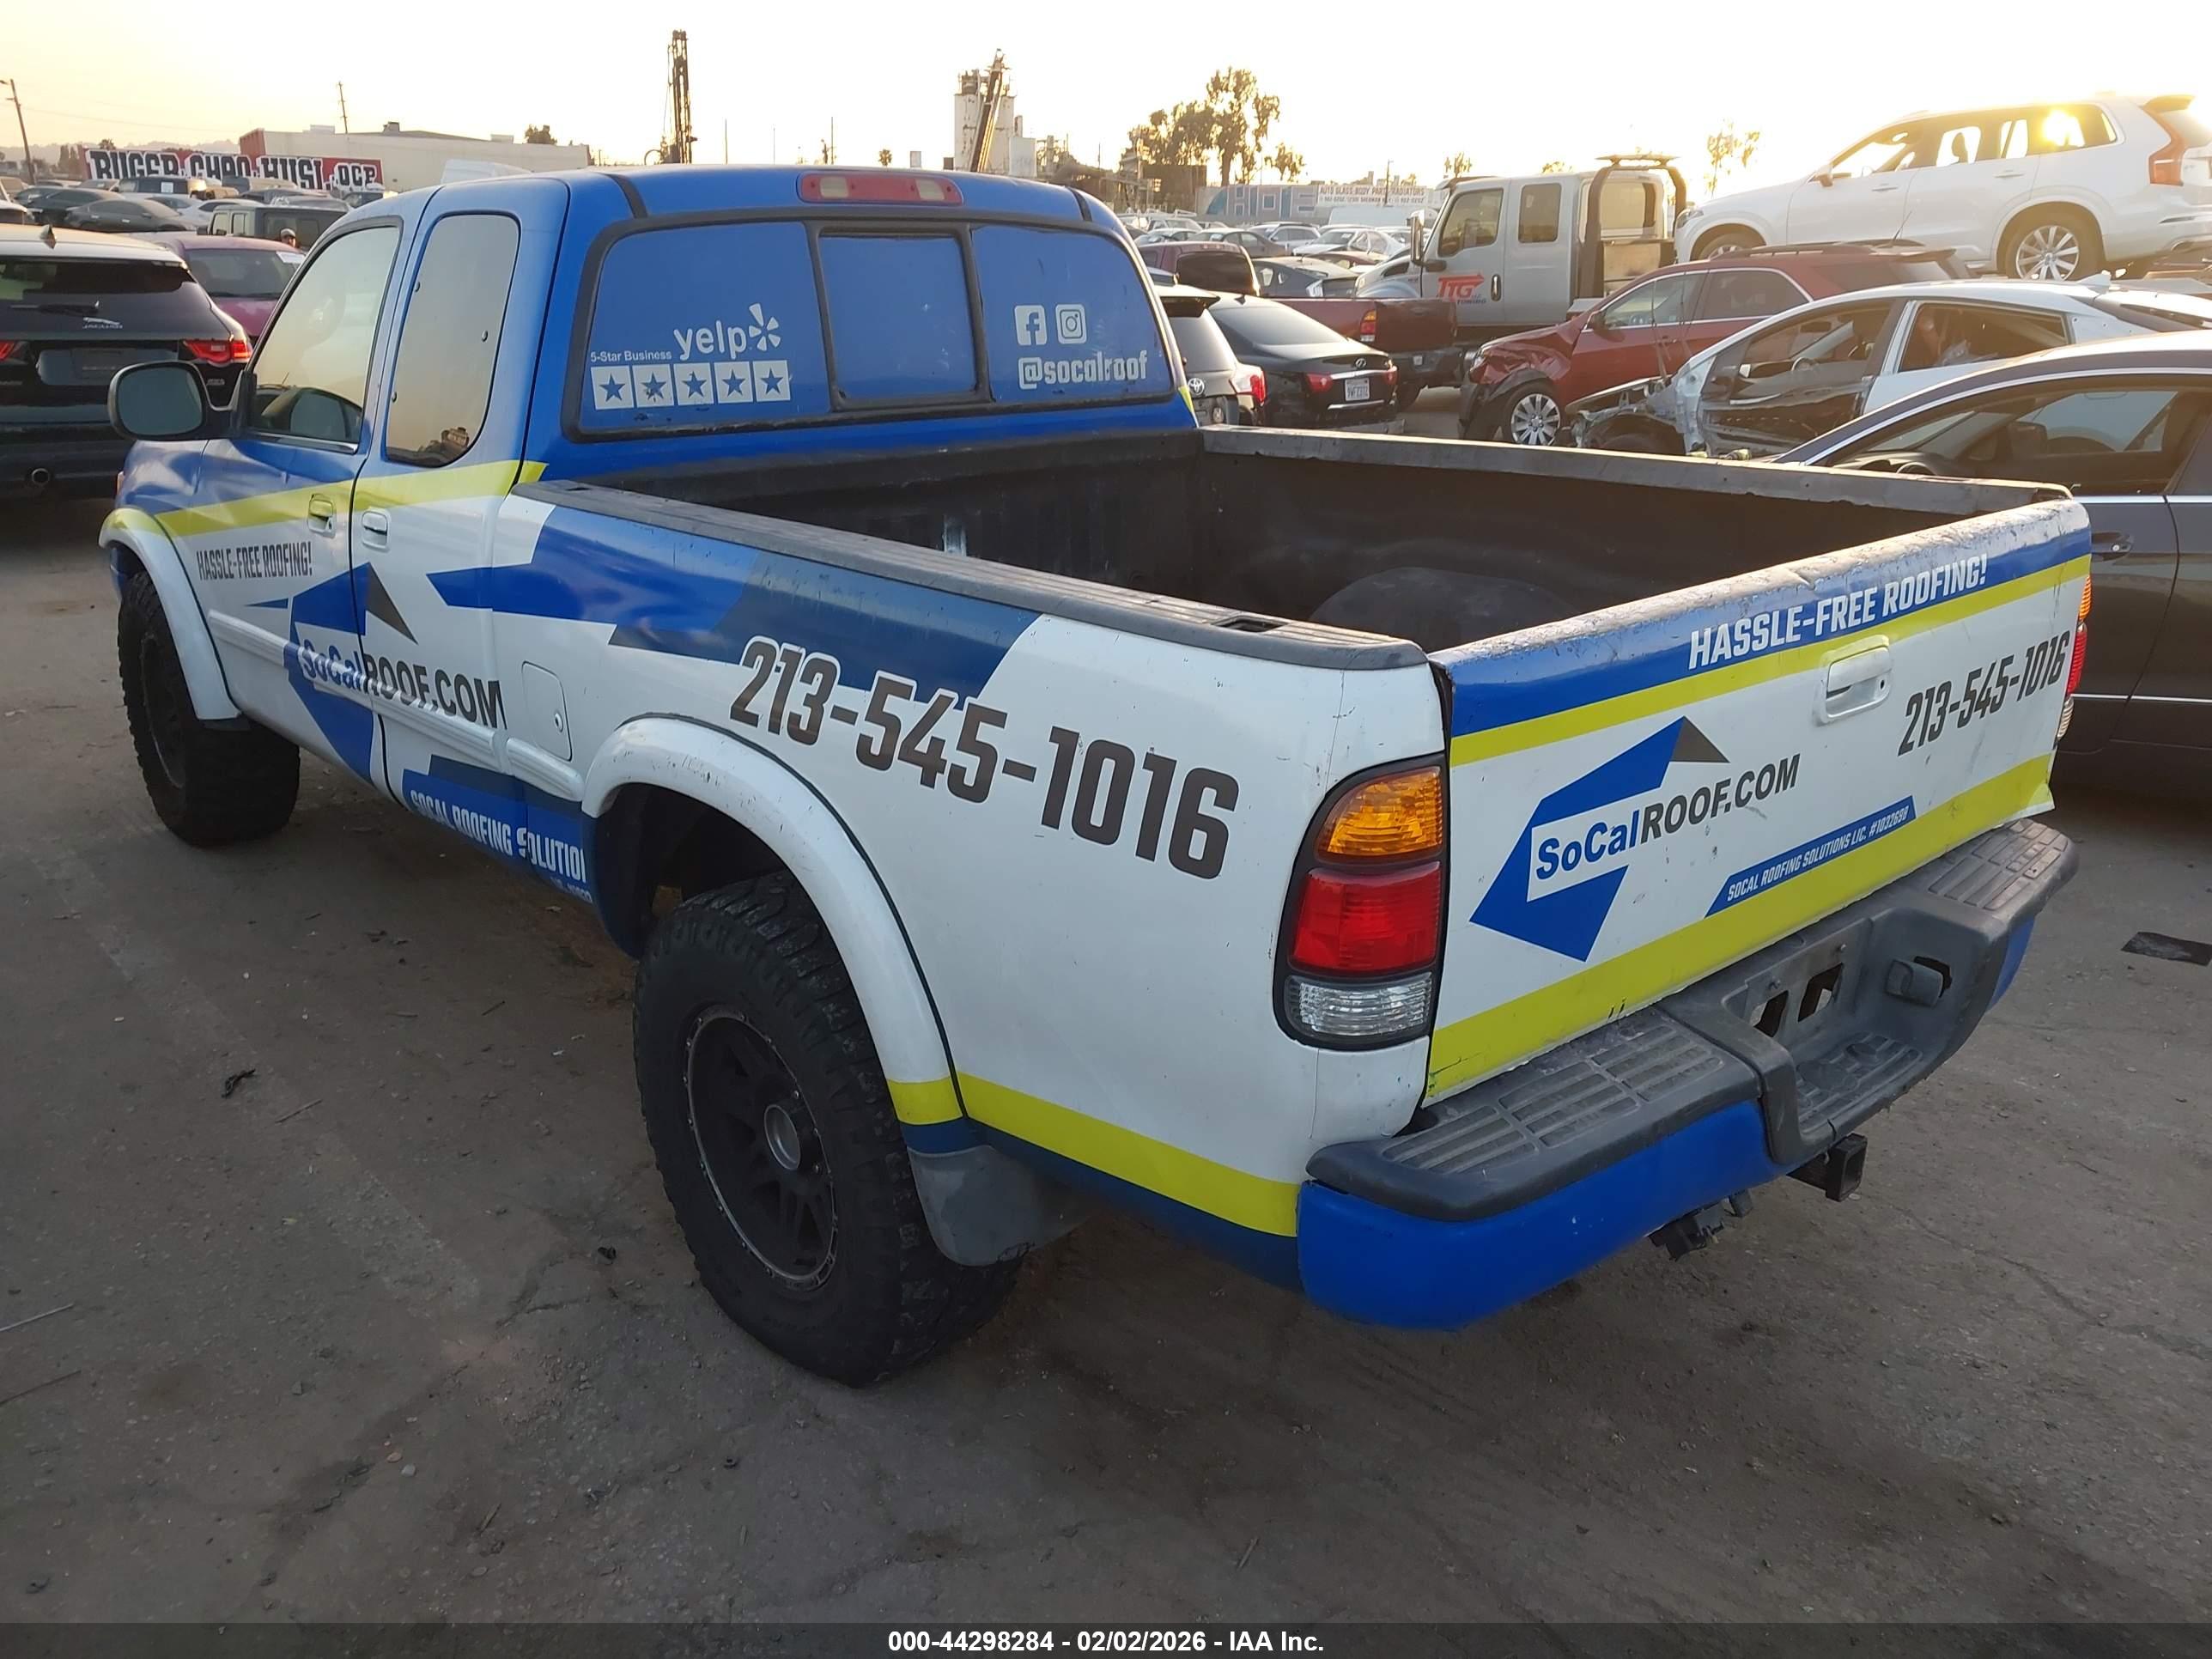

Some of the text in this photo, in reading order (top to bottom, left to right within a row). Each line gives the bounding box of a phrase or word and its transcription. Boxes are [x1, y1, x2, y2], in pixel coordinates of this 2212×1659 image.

[590, 350, 672, 362] 5-Star Business
[673, 319, 747, 361] yelp
[1018, 349, 1148, 390] @socalroof
[197, 541, 313, 580] HASSLE-FREE ROOFING!
[1688, 554, 1988, 671] HASSLE-FREE ROOFING!
[1897, 630, 2071, 757] 213-545-1016
[729, 640, 1240, 880] 213-545-1016
[410, 789, 455, 830] SOCAL
[452, 804, 514, 856] ROOFING
[1535, 753, 1801, 881] SoCalROOF.COM
[1727, 876, 1759, 902] SOCAL
[1760, 856, 1803, 887] ROOFING
[1802, 835, 1851, 868] SOLUTIONS
